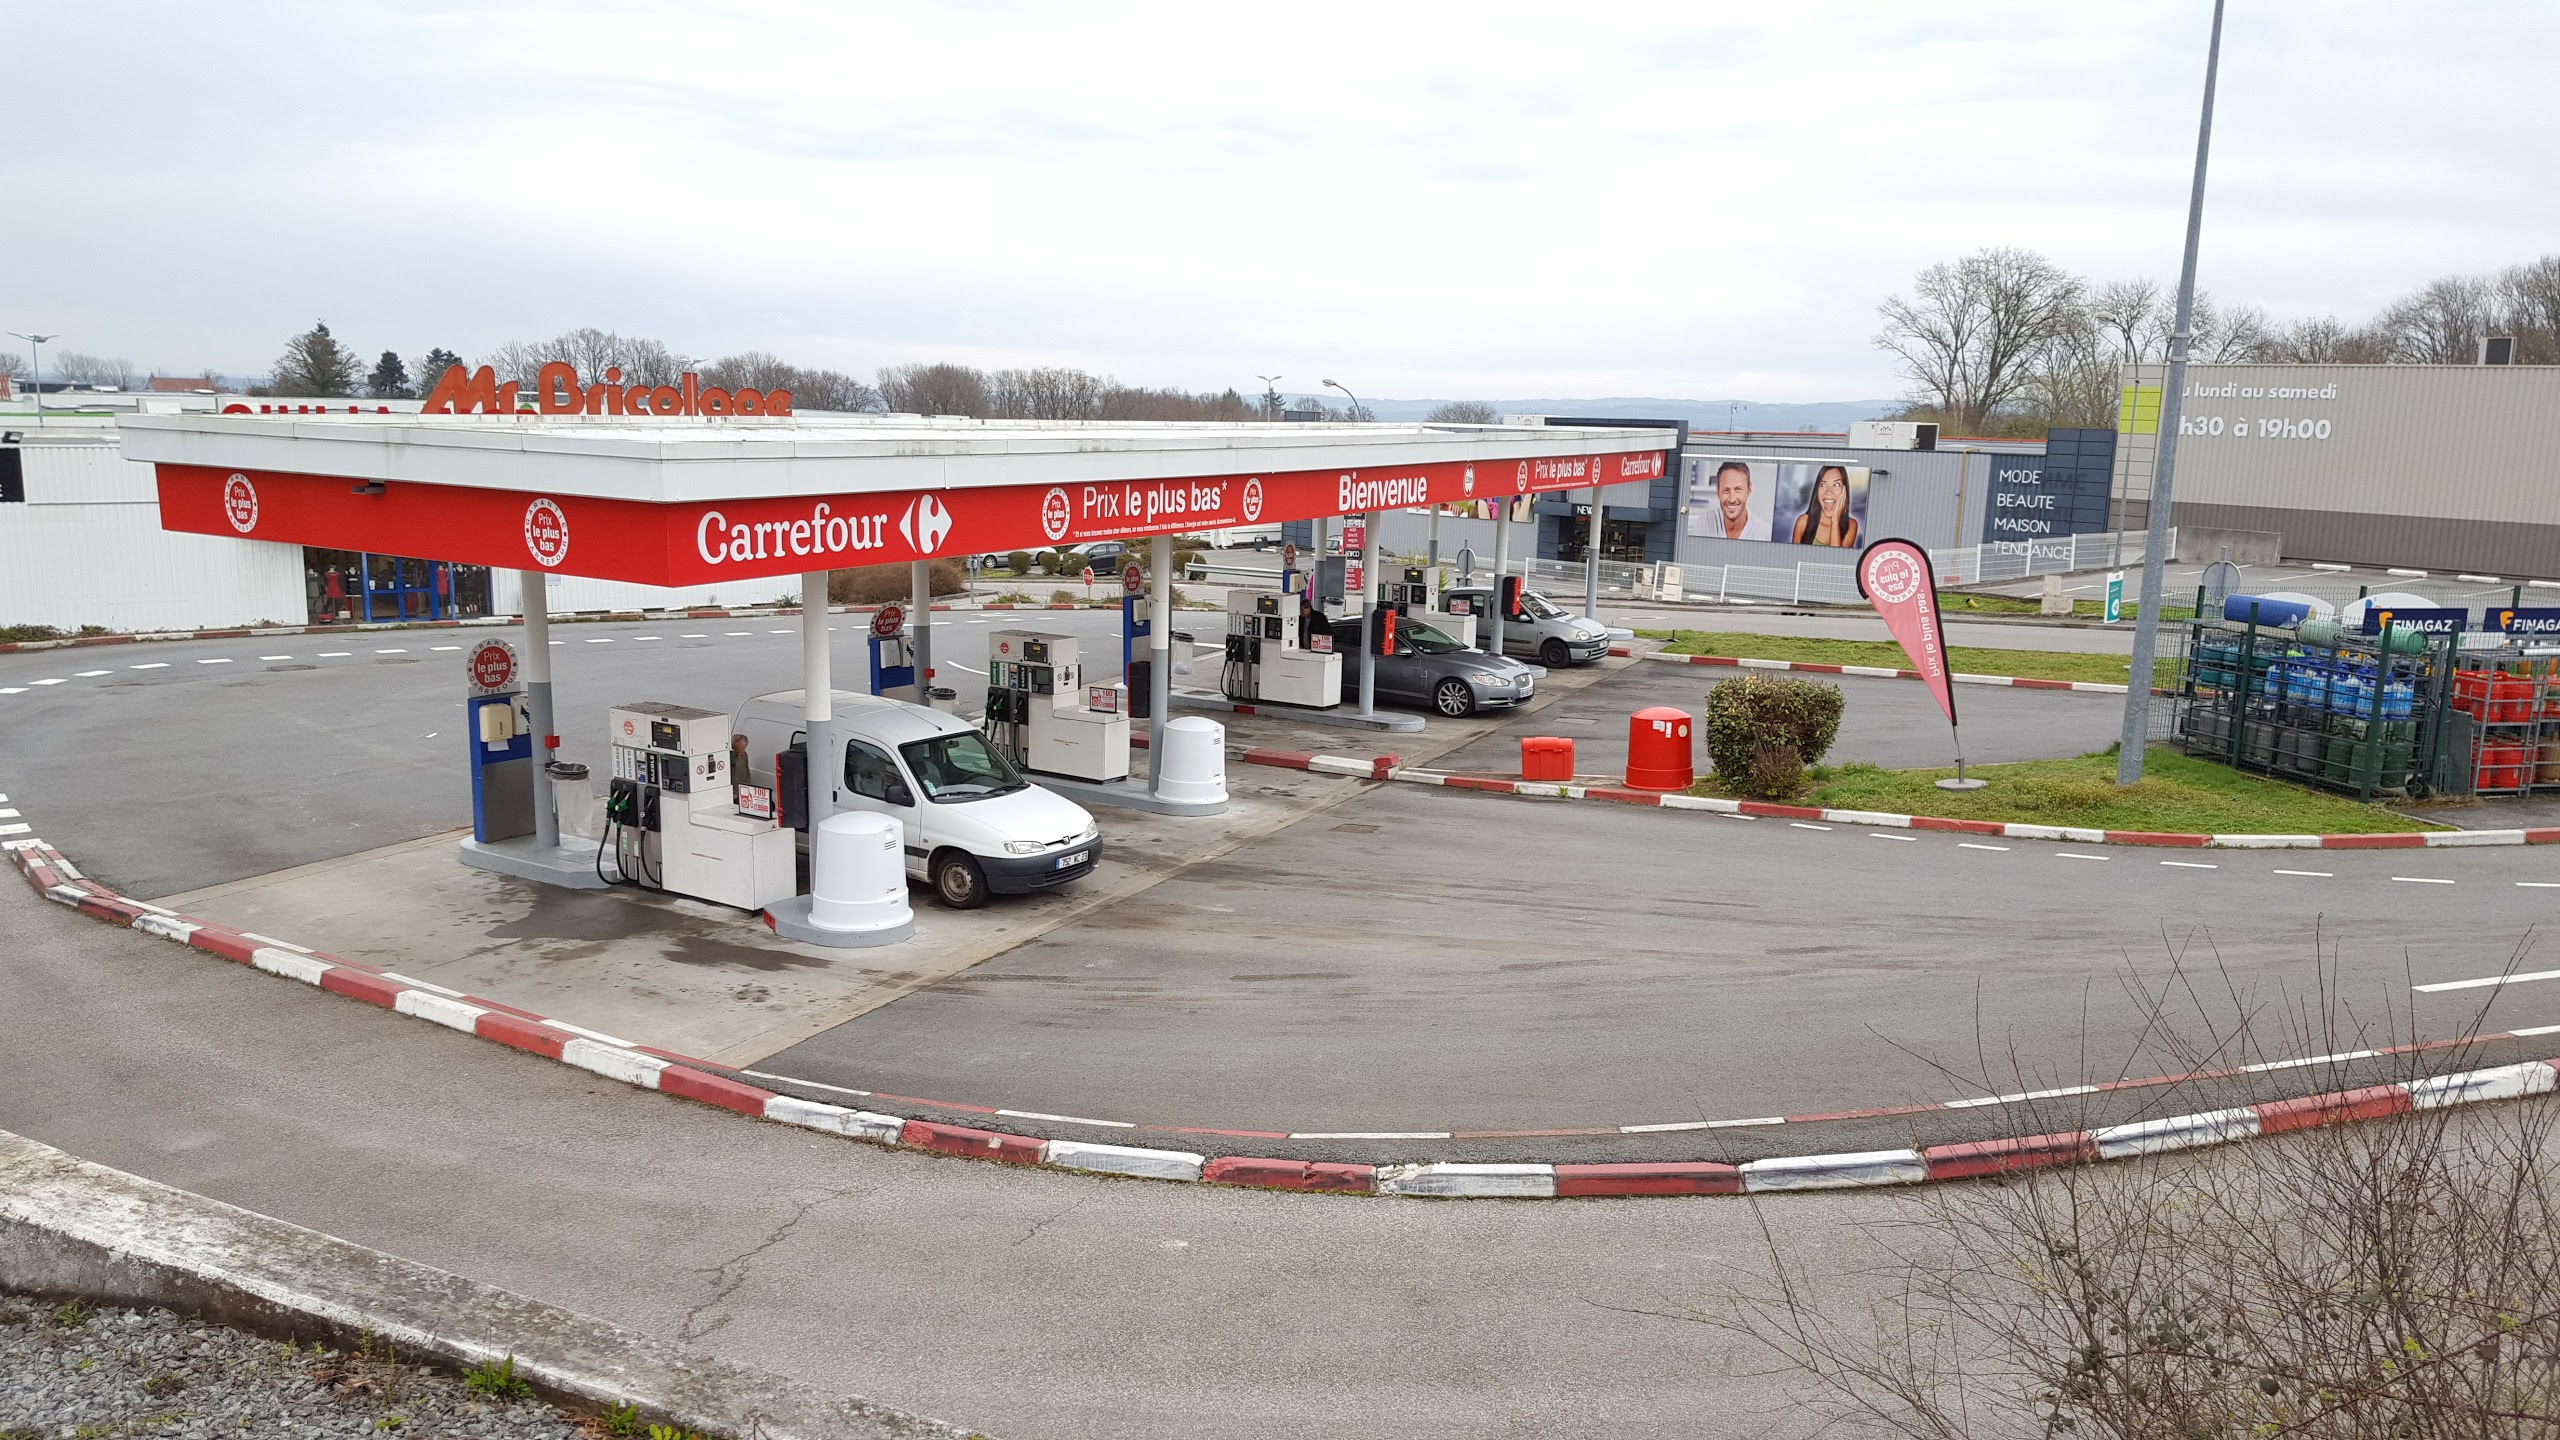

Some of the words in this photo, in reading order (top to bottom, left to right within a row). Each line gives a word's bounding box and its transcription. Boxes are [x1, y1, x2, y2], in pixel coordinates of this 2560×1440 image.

[2194, 381, 2238, 398] lundi
[2241, 387, 2264, 398] au
[2268, 383, 2338, 399] samedi
[2179, 415, 2225, 437] h30
[2233, 416, 2249, 437] à
[2258, 417, 2332, 440] 19h00
[1535, 460, 1548, 480] Prix
[1549, 459, 1556, 478] le
[1556, 459, 1573, 484] plus
[1621, 454, 1651, 477] Carrefour
[1999, 469, 2042, 484] MODE
[1338, 471, 1428, 512] Bienvenue
[1083, 485, 1120, 520] Prix
[1125, 483, 1142, 517] le
[1147, 482, 1186, 524] plus
[1996, 493, 2056, 510] BEAUTE
[538, 513, 553, 526] Prix
[1994, 517, 2051, 534] MAISON
[533, 525, 541, 537] le
[542, 526, 560, 540] plus
[697, 502, 888, 565] Carrefour
[540, 538, 555, 552] bas
[1993, 540, 2073, 560] TENDANCE
[2393, 619, 2453, 633] FINAGAZ
[468, 640, 516, 664] GARANTIE
[483, 651, 500, 662] Prix
[477, 663, 486, 673] le
[488, 661, 508, 673] plus
[469, 671, 517, 694] CARREFOUR
[484, 673, 502, 683] bas
